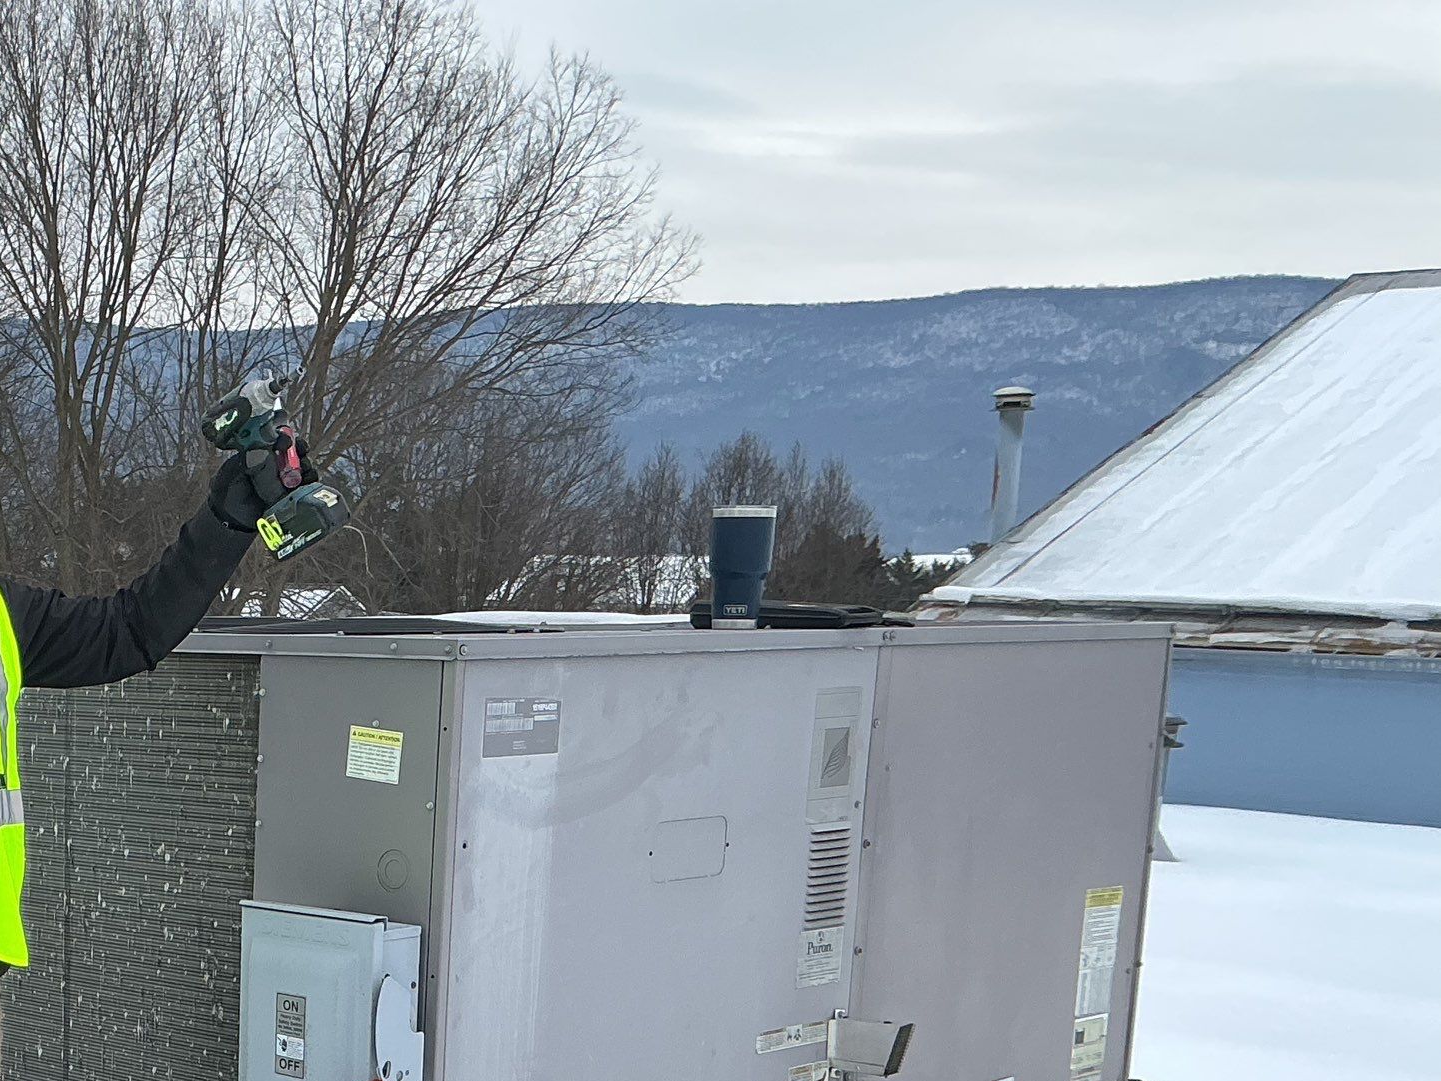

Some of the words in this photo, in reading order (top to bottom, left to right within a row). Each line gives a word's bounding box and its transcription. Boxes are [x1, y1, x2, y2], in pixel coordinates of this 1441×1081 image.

[725, 606, 745, 614] YETI
[283, 999, 299, 1012] ON
[279, 1058, 300, 1071] OFF
